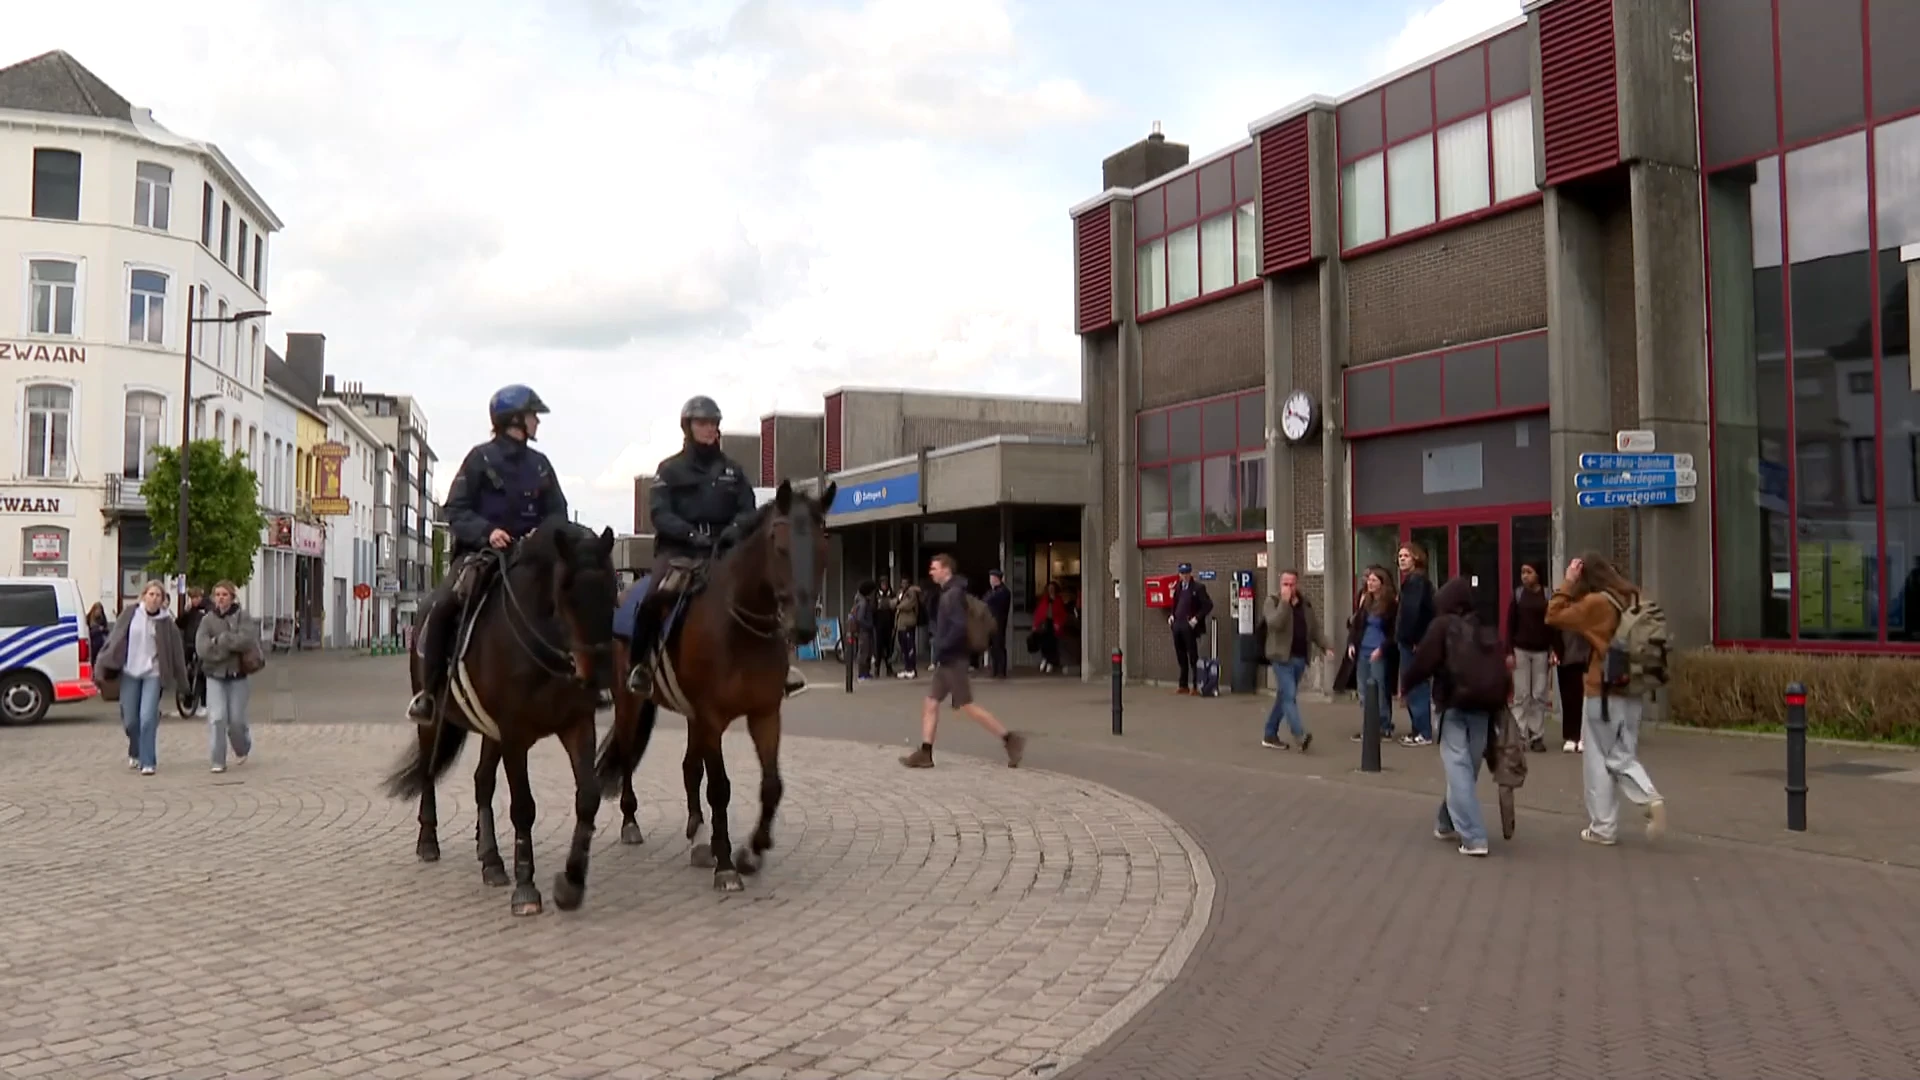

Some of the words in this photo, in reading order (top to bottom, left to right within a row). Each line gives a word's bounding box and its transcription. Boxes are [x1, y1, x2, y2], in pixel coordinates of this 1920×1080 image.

[0, 343, 86, 363] ZWAAN
[0, 497, 60, 513] WAAN
[1241, 573, 1250, 587] P
